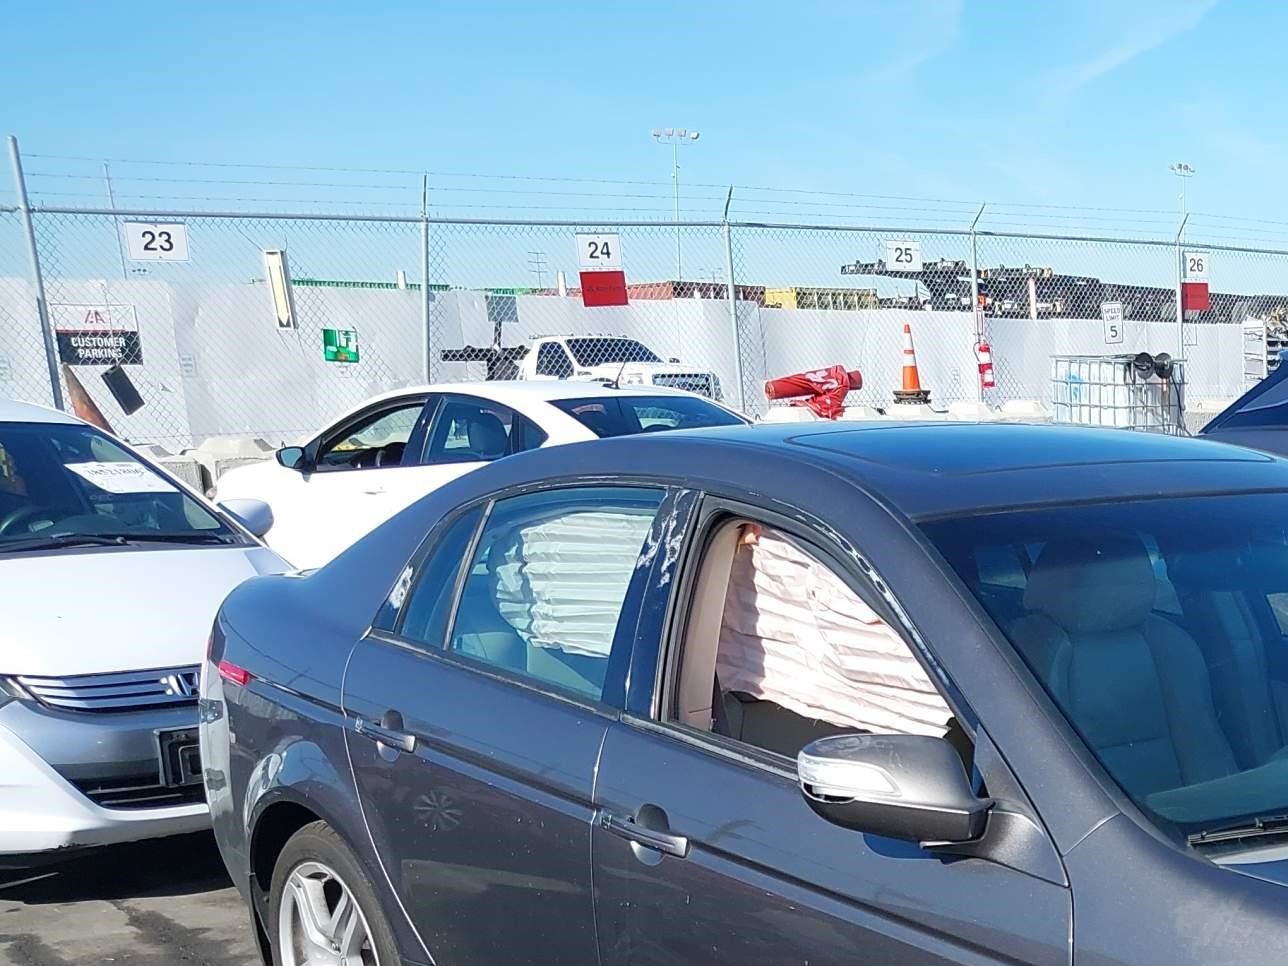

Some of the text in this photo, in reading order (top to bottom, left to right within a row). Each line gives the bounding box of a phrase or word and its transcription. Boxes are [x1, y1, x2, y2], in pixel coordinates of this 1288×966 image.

[142, 231, 173, 251] 23
[588, 242, 611, 259] 24
[895, 247, 913, 263] 25
[1190, 258, 1204, 272] 26
[1110, 325, 1118, 338] 5
[71, 336, 126, 348] CUSTOMER
[78, 348, 122, 359] PARKING
